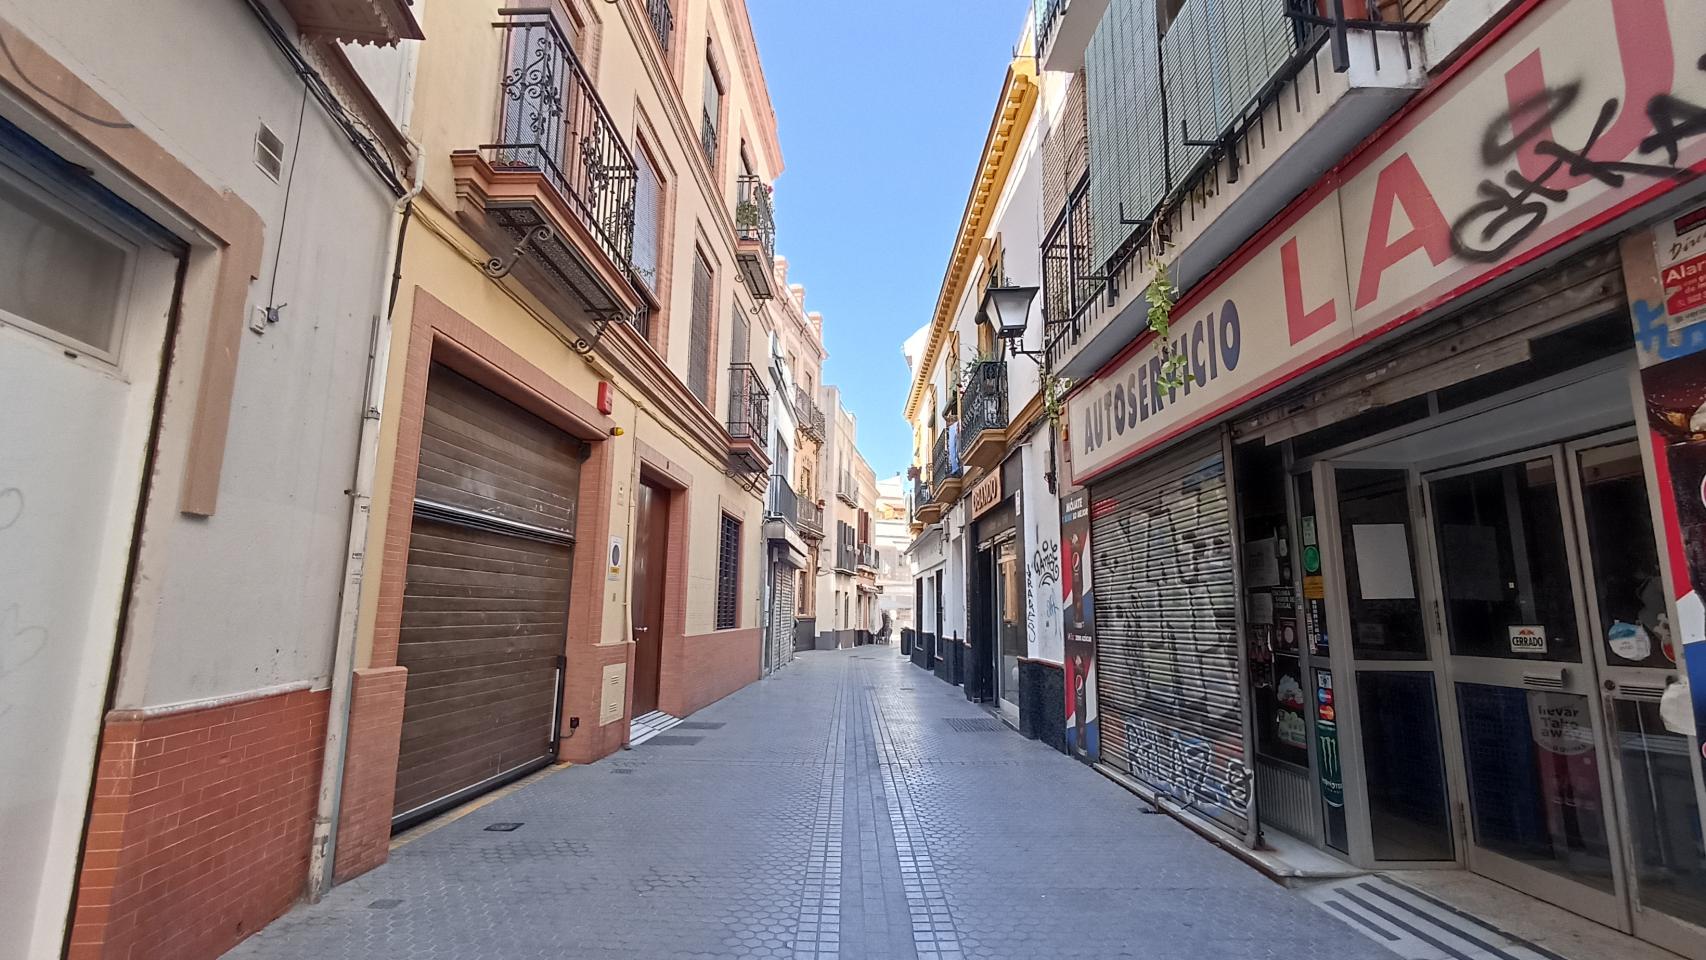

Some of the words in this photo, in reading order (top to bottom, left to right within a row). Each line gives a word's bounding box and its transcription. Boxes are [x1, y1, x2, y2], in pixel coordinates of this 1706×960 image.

[1666, 260, 1706, 283] Alar
[1085, 299, 1241, 455] AUTOSERVICIO
[1280, 152, 1454, 347] LA
[1512, 636, 1544, 647] CERRADO
